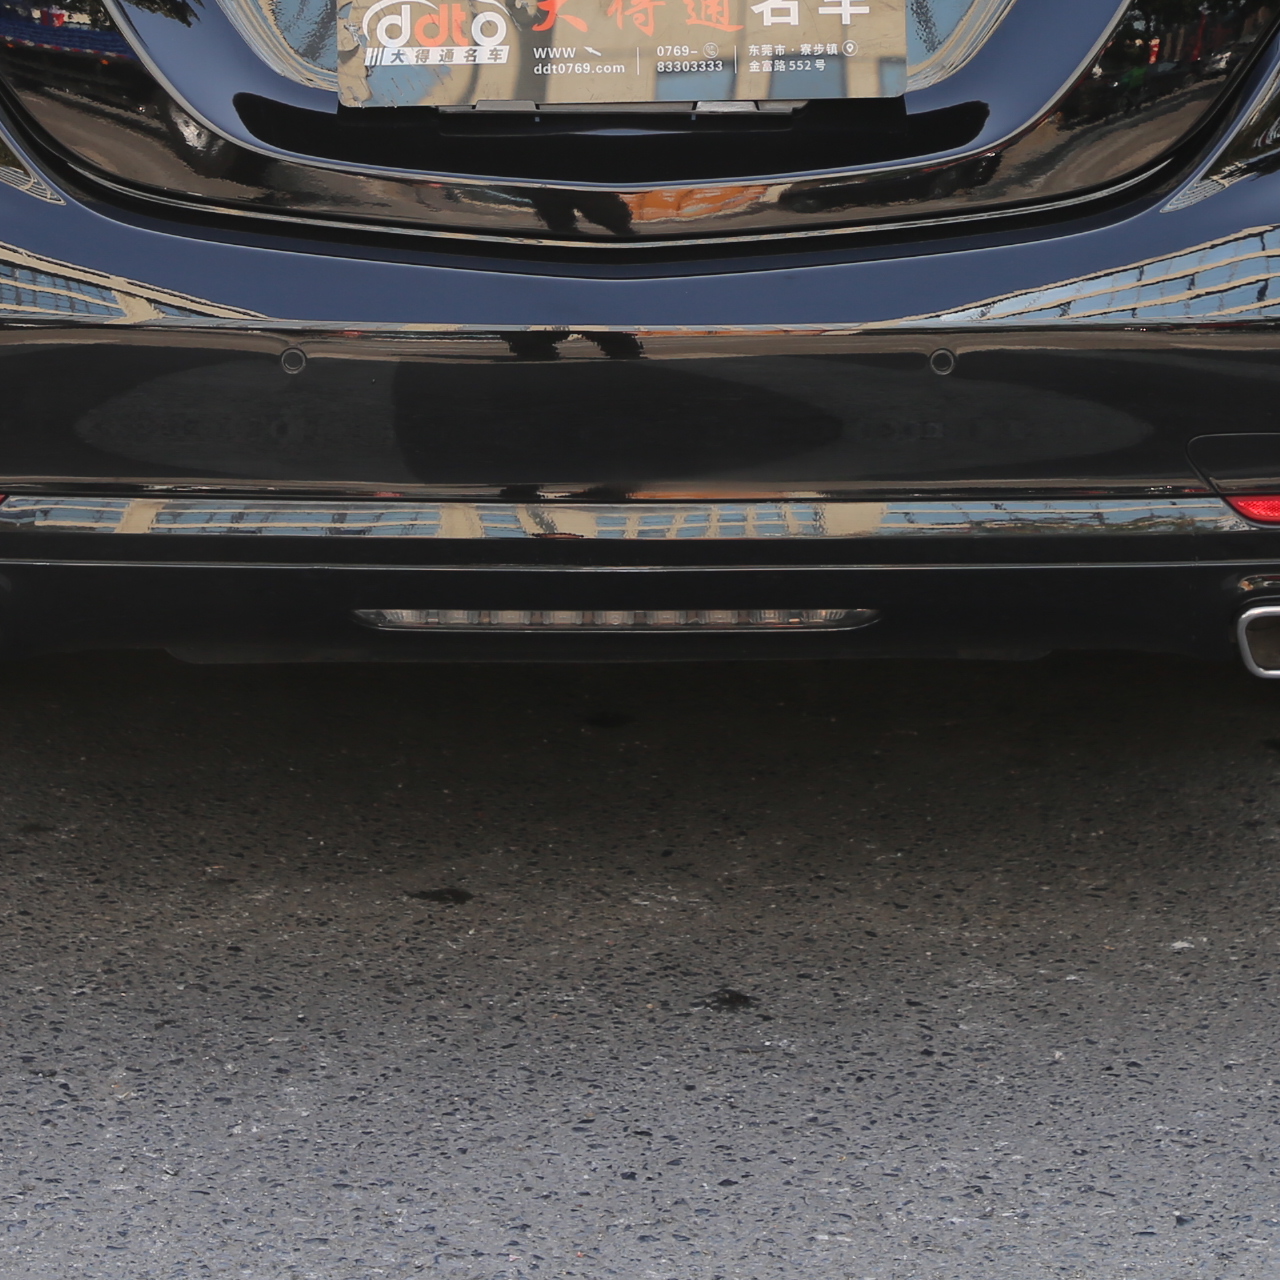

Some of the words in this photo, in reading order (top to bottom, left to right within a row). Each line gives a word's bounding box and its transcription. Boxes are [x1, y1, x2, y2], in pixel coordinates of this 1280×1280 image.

[390, 48, 504, 64] 大得通名车
[533, 62, 625, 74] ddt0769.com
[656, 60, 723, 73] 83303333
